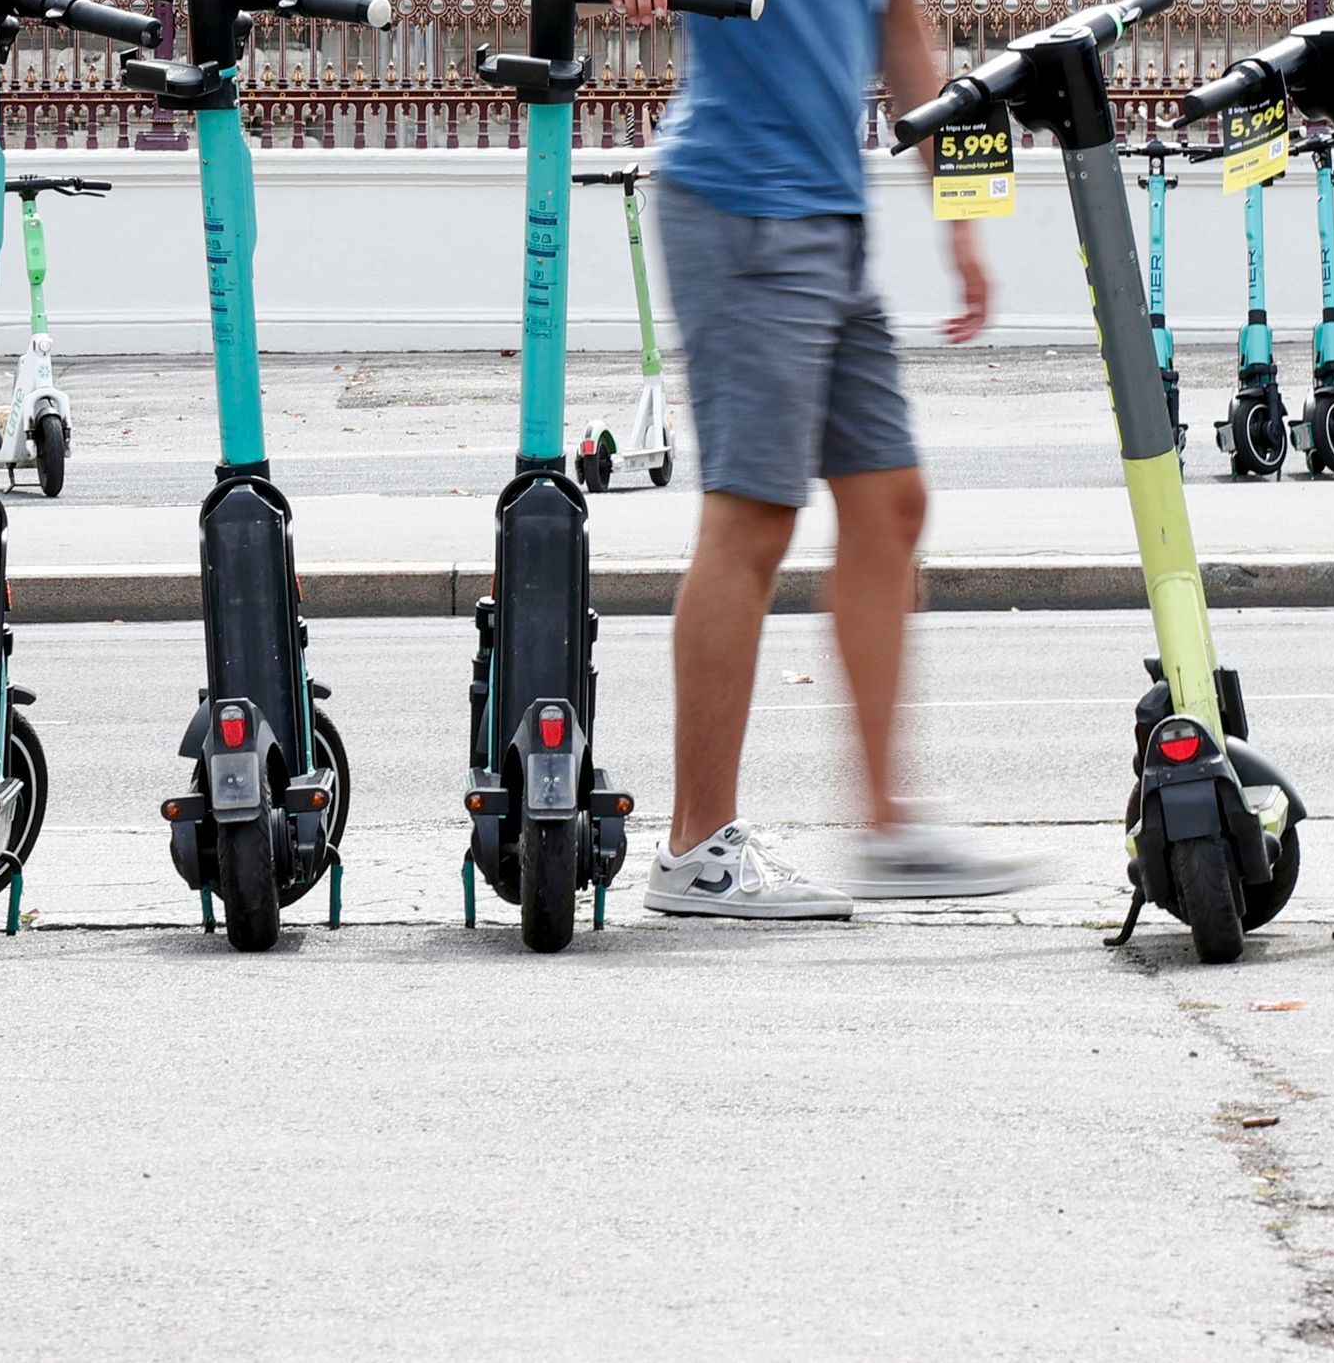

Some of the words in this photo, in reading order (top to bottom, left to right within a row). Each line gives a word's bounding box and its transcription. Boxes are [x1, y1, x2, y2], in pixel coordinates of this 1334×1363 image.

[946, 125, 961, 133] trips
[972, 122, 987, 132] only
[1230, 99, 1285, 138] 5,99€
[940, 131, 1008, 160] 5,99€
[1151, 254, 1162, 310] TIER
